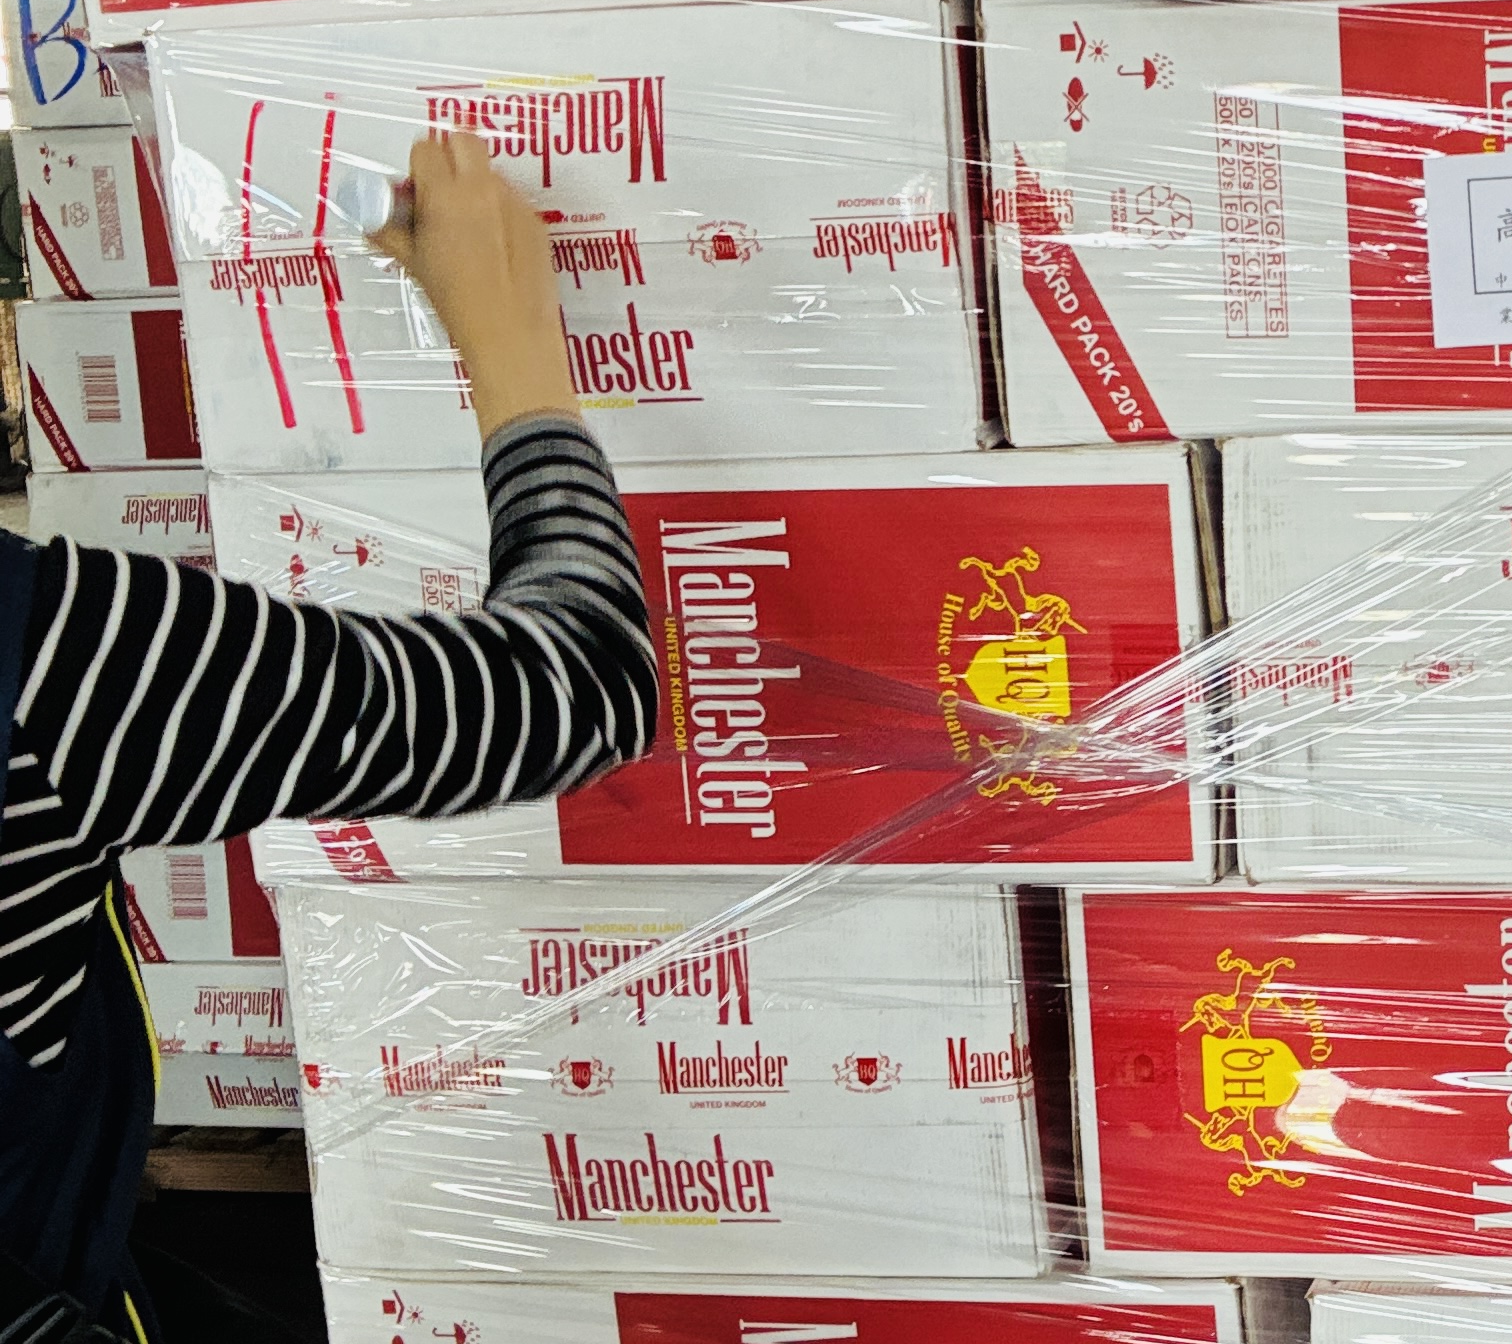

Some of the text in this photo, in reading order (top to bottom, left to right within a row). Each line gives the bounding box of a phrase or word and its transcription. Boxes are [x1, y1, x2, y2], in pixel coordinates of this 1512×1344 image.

[812, 212, 957, 274] Manchester
[1028, 245, 1078, 317] HARD
[1070, 315, 1121, 387] PACK
[1108, 386, 1144, 434] 20's
[122, 493, 209, 536] Manchester
[425, 574, 440, 607] 500
[937, 593, 965, 655] House
[658, 518, 809, 840] Manchester
[664, 616, 688, 753] UNITED KINGDOM
[936, 660, 953, 682] of
[995, 645, 1050, 703] HQ
[583, 923, 684, 934] UNITED KINGDOM
[520, 928, 754, 1027] Manchester
[194, 987, 285, 1028] Manchester
[205, 1074, 300, 1109] Manchester
[656, 1040, 789, 1095] Manchester
[1220, 1046, 1274, 1102] HQ
[689, 1099, 767, 1110] UNITED KINGDOM
[542, 1132, 781, 1223] Manchester
